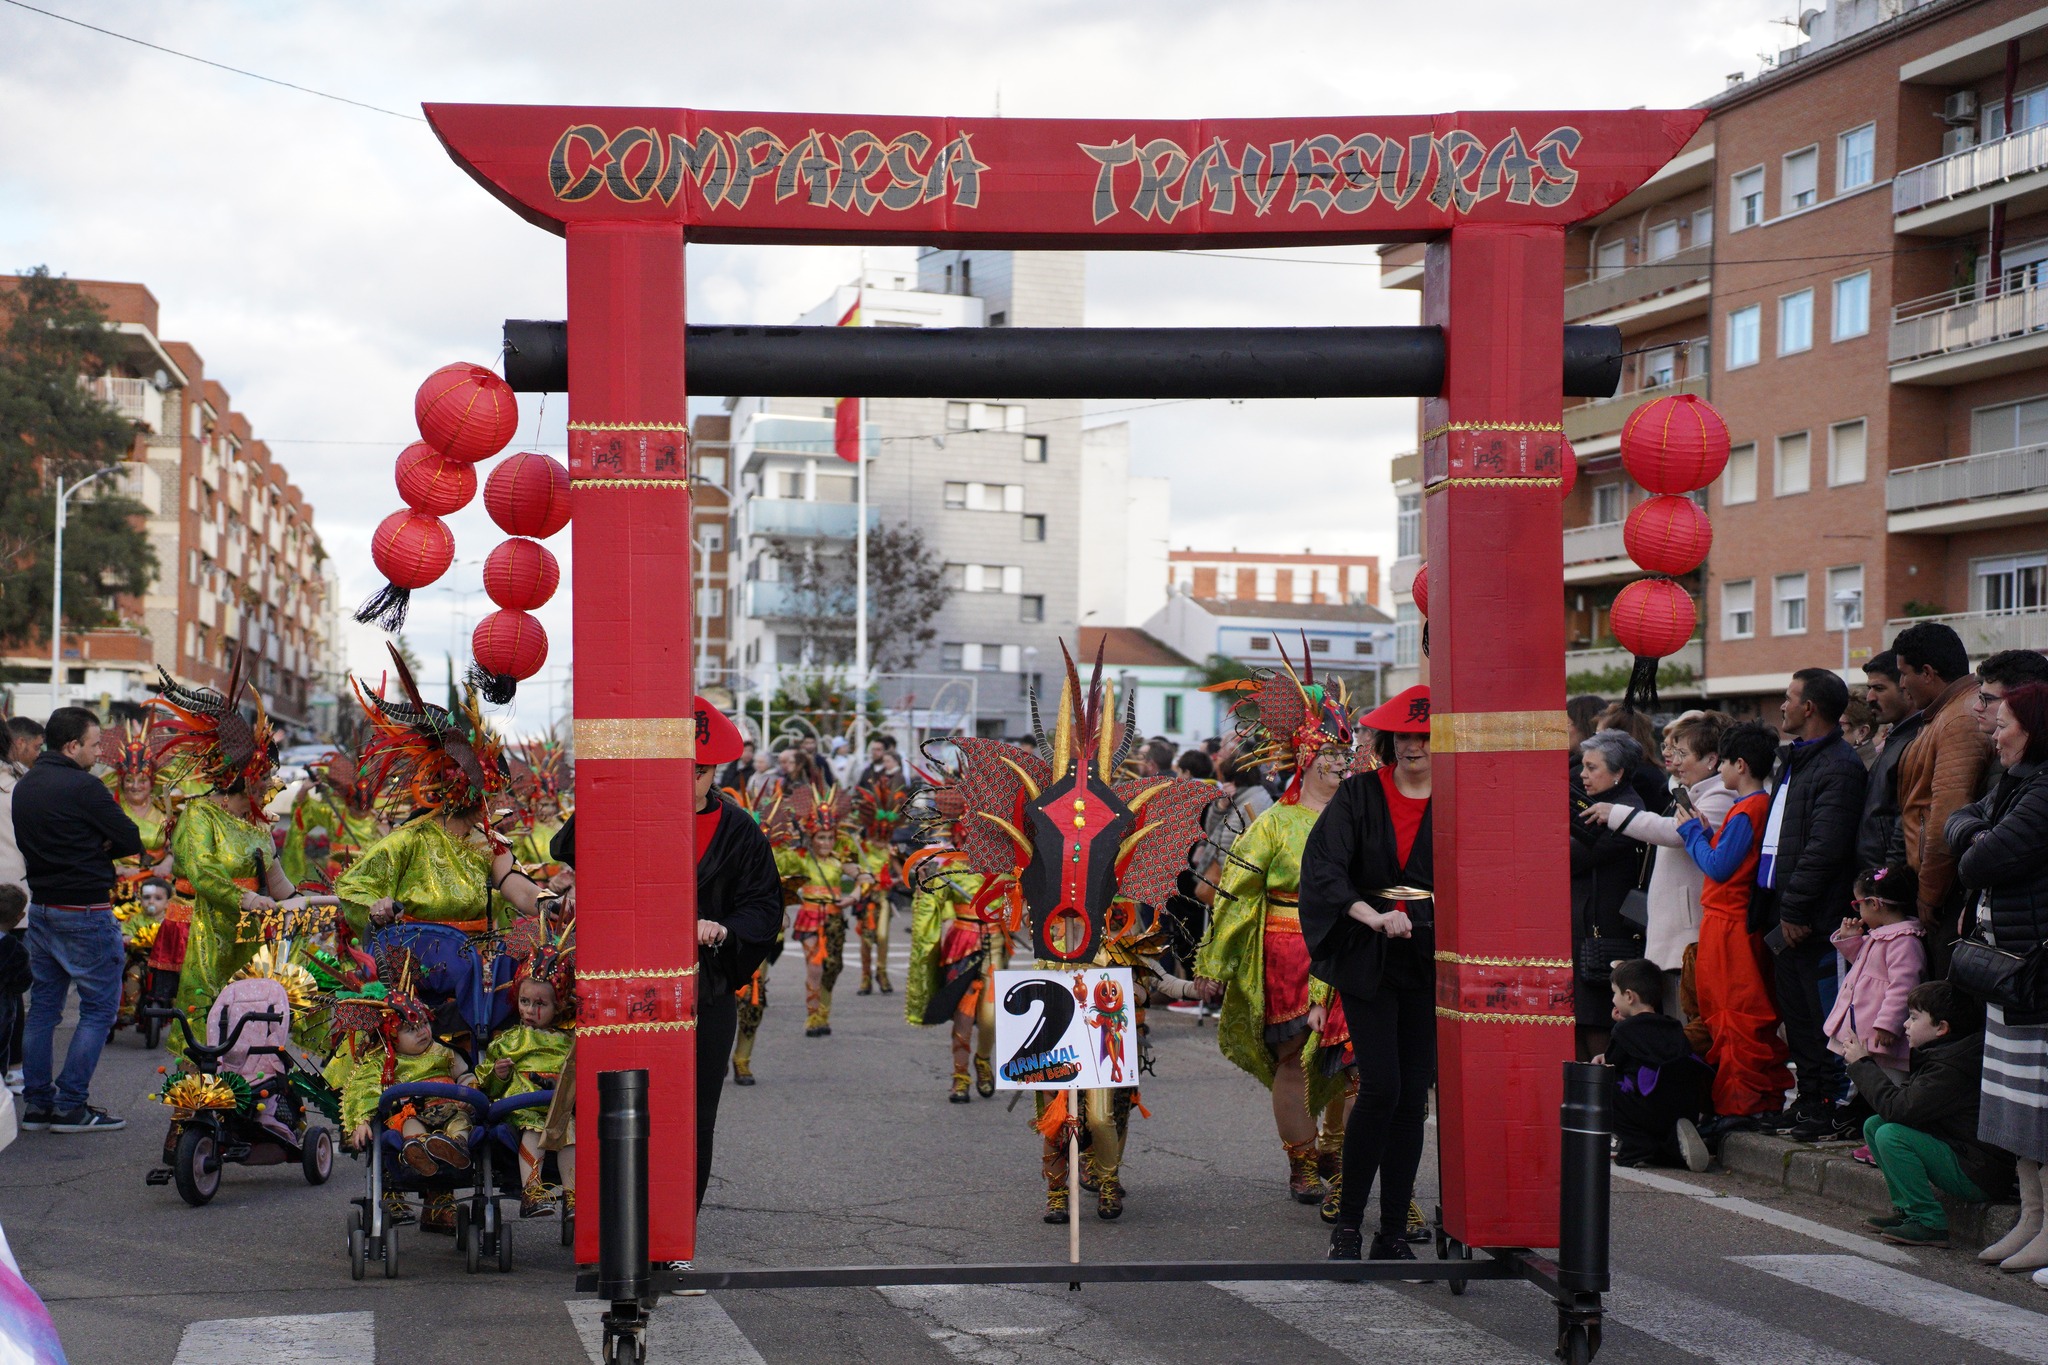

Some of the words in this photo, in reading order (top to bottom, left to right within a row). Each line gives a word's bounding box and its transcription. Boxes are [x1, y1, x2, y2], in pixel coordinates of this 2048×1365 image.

[548, 124, 991, 217] COMPARSA
[1076, 126, 1583, 225] TRAVESURAS
[1405, 697, 1431, 723] 勇
[1004, 979, 1078, 1083] 2
[999, 1045, 1080, 1081] CARNAVAL
[1024, 1070, 1045, 1084] DON
[1046, 1061, 1083, 1080] BENITO
